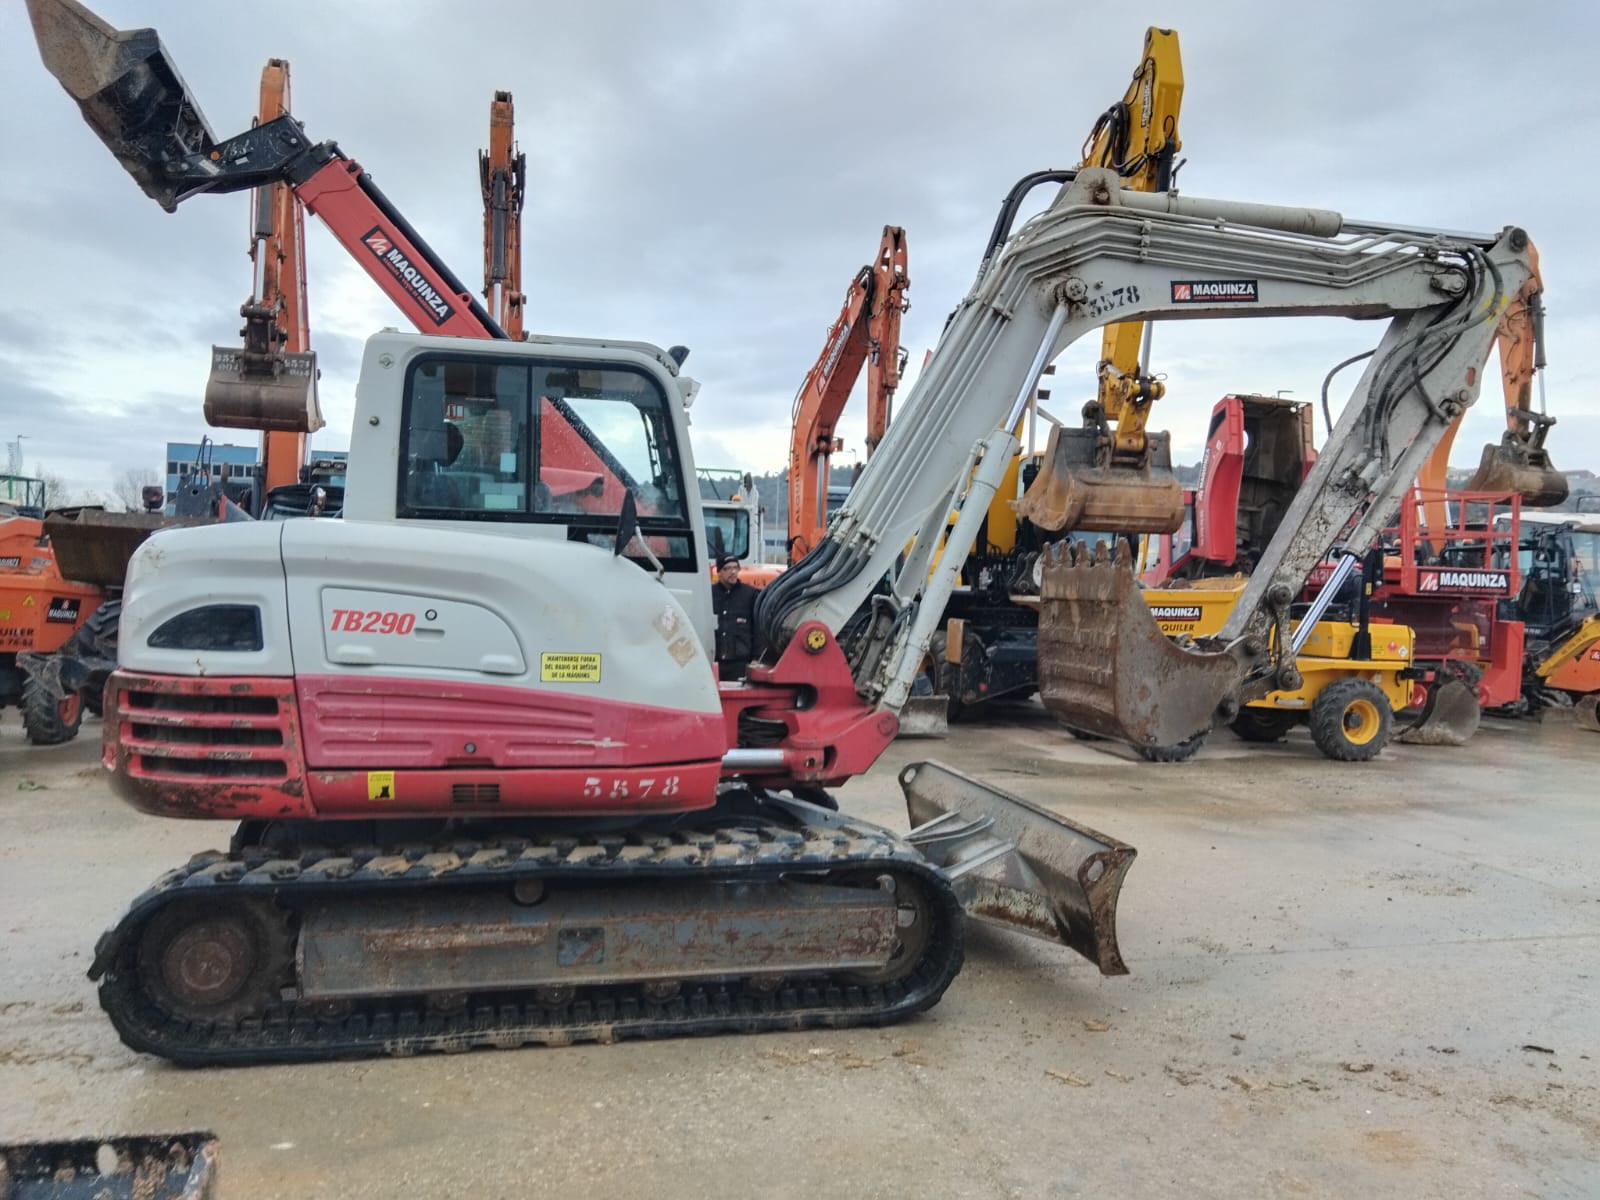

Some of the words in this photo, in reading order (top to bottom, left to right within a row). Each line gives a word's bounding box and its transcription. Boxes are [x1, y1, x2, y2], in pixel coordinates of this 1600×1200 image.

[386, 248, 449, 318] MAQUINZA
[1193, 283, 1255, 295] MAQUINZA
[1440, 572, 1507, 587] MAQUINZA
[1151, 607, 1200, 617] MAQUINZA
[331, 609, 416, 636] TB290
[547, 655, 579, 663] MANTENERSE
